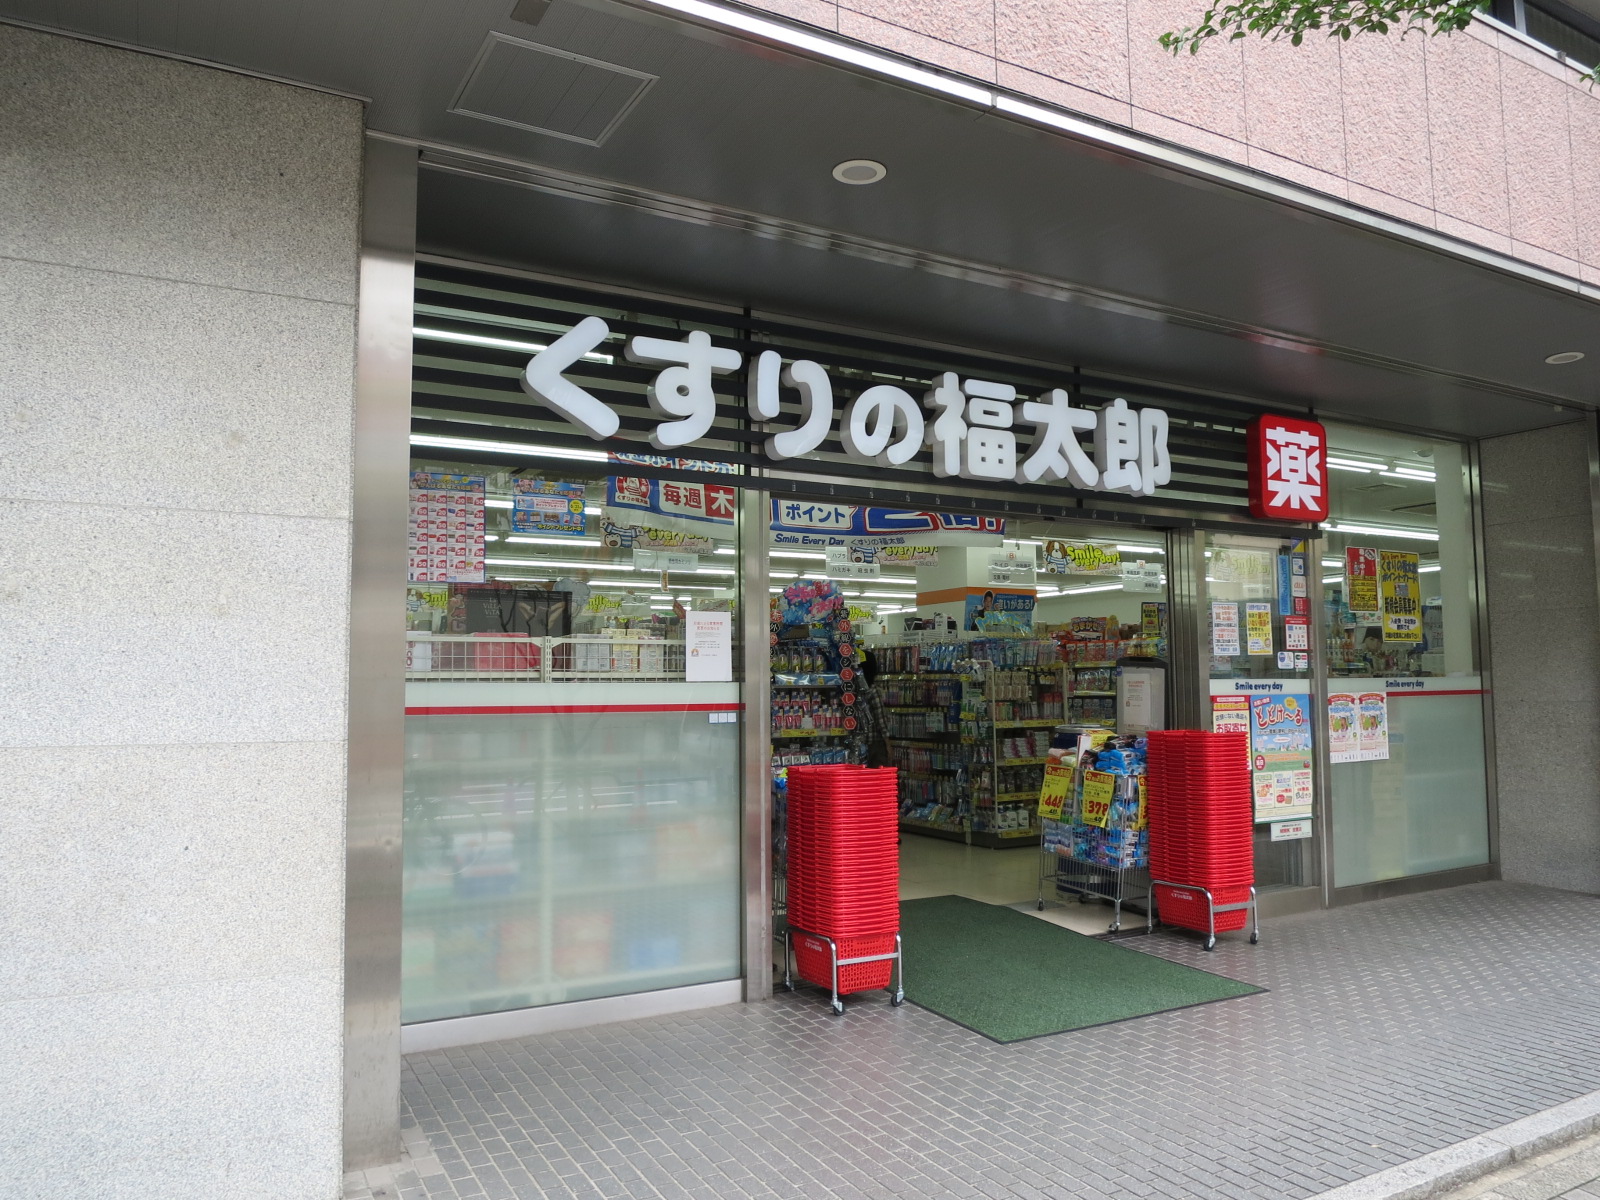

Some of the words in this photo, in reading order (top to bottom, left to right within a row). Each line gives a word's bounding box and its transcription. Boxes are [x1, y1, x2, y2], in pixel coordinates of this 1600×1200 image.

[521, 316, 1171, 497] くすりの福太郎
[1265, 426, 1322, 511] 薬
[785, 504, 846, 523] ポイント
[775, 533, 799, 544] Smile
[801, 536, 825, 546] Every
[829, 537, 845, 546] Day
[1066, 544, 1103, 559] Smile
[1075, 557, 1100, 568] every
[1100, 553, 1121, 565] day!
[1235, 682, 1254, 690] Smile
[1254, 684, 1271, 692] every
[1272, 682, 1283, 691] day
[1400, 681, 1415, 689] every
[1415, 680, 1424, 688] day
[1045, 794, 1063, 809] 448
[1088, 800, 1109, 816] 378
